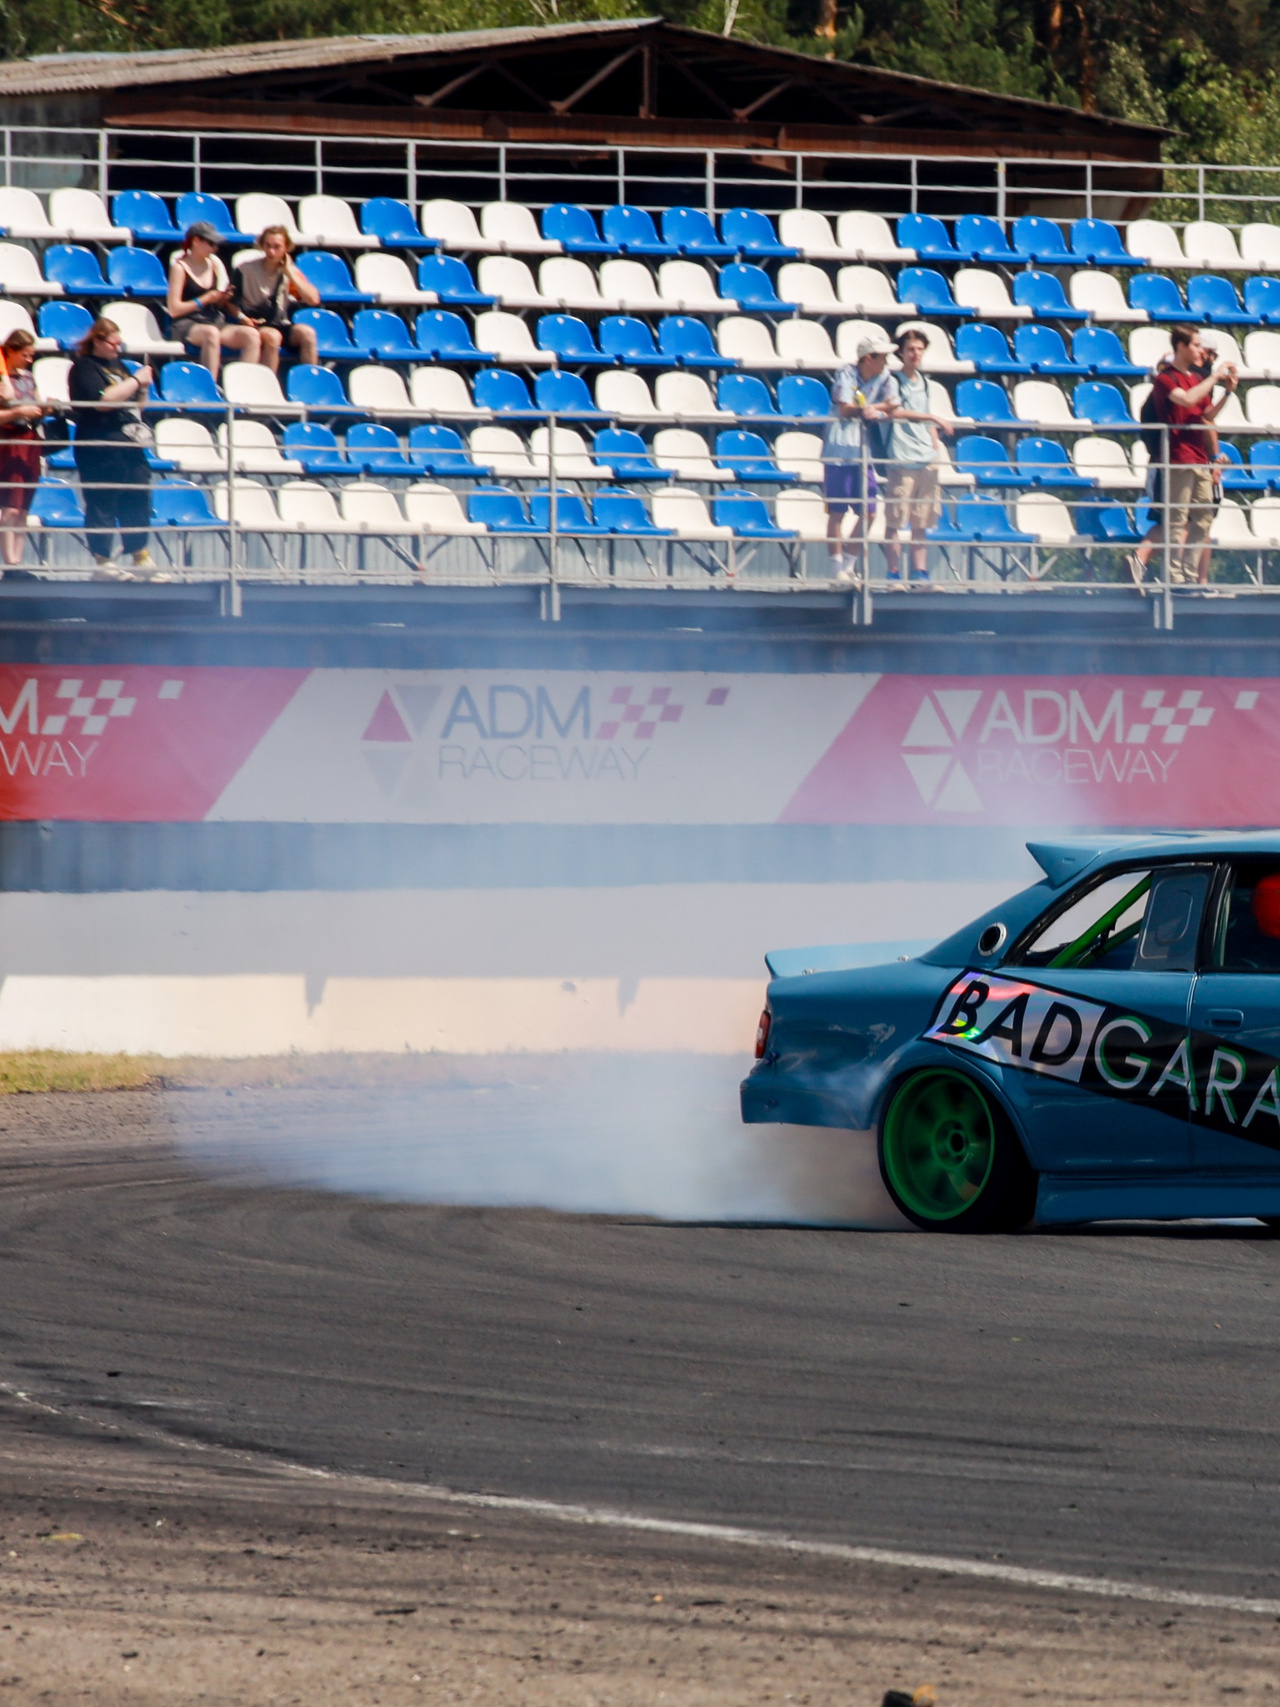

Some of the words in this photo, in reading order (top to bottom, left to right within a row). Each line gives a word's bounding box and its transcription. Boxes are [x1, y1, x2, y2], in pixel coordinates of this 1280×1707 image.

[440, 685, 591, 739] ADM
[979, 689, 1124, 744] ADM
[438, 745, 650, 781] RACEWAY
[976, 748, 1179, 783] RACEWAY
